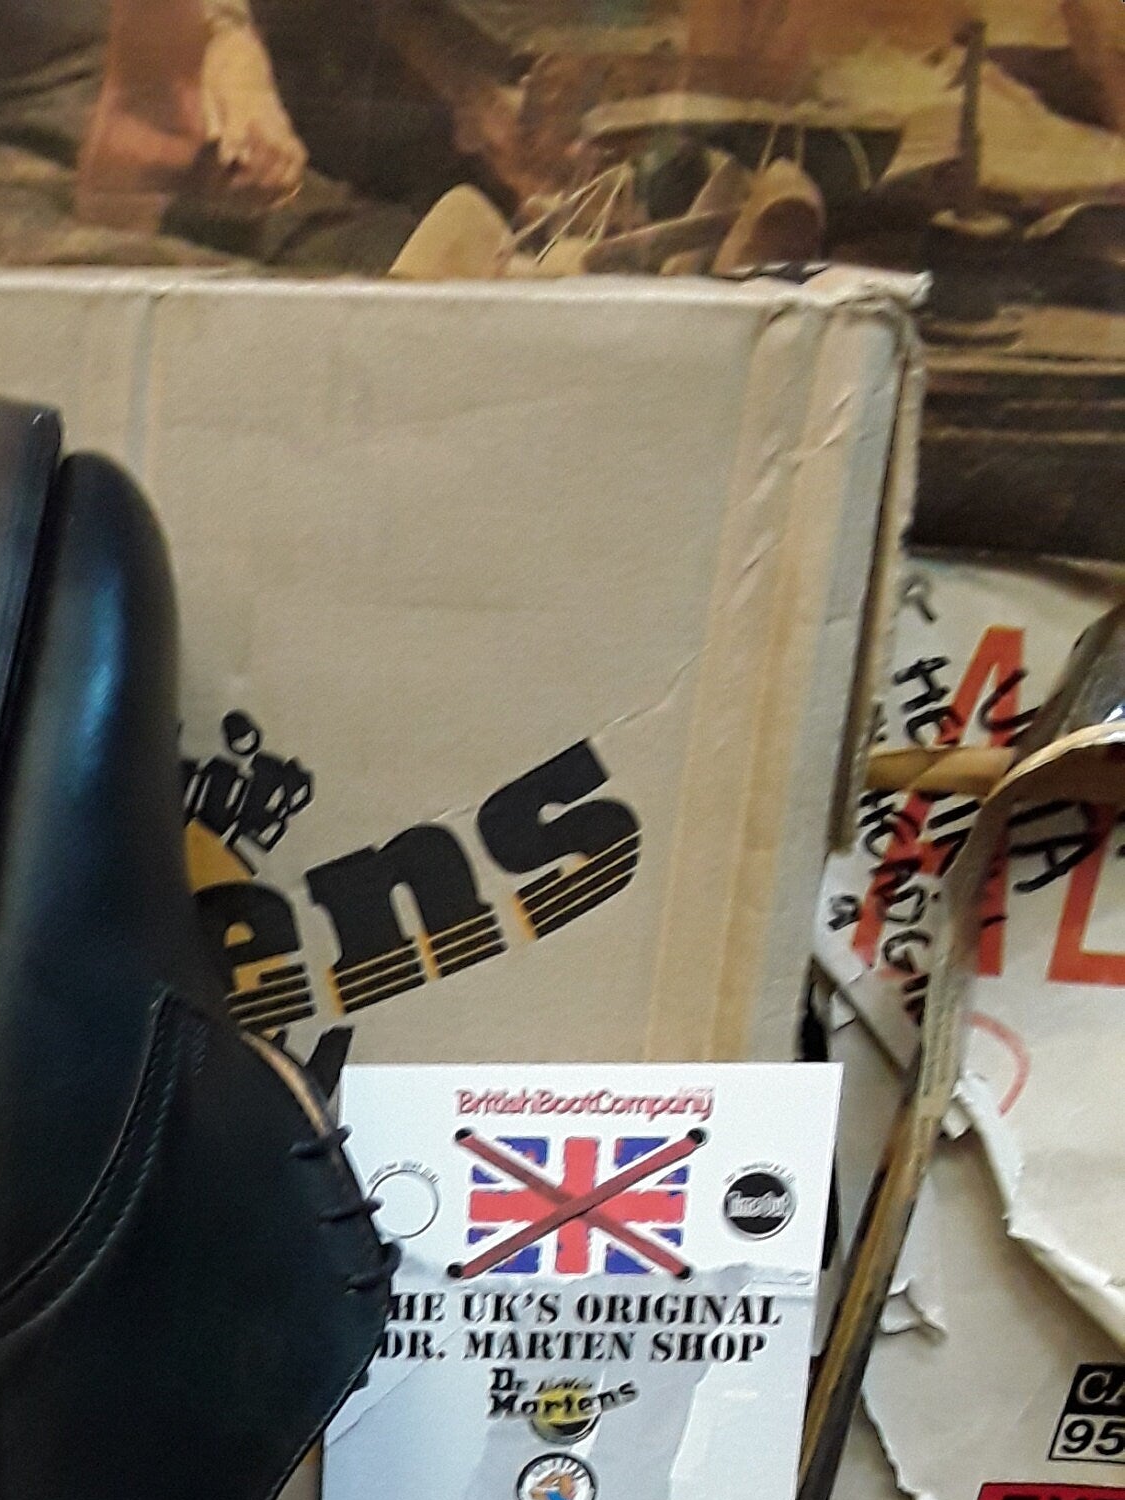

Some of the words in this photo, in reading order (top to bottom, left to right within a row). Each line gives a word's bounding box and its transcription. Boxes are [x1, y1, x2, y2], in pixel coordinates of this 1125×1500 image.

[387, 1292, 446, 1321] HE
[576, 1294, 782, 1326] ORIGINAL
[379, 1331, 446, 1359] DR.
[463, 1331, 636, 1361] MARTEN
[650, 1333, 768, 1363] SHOP
